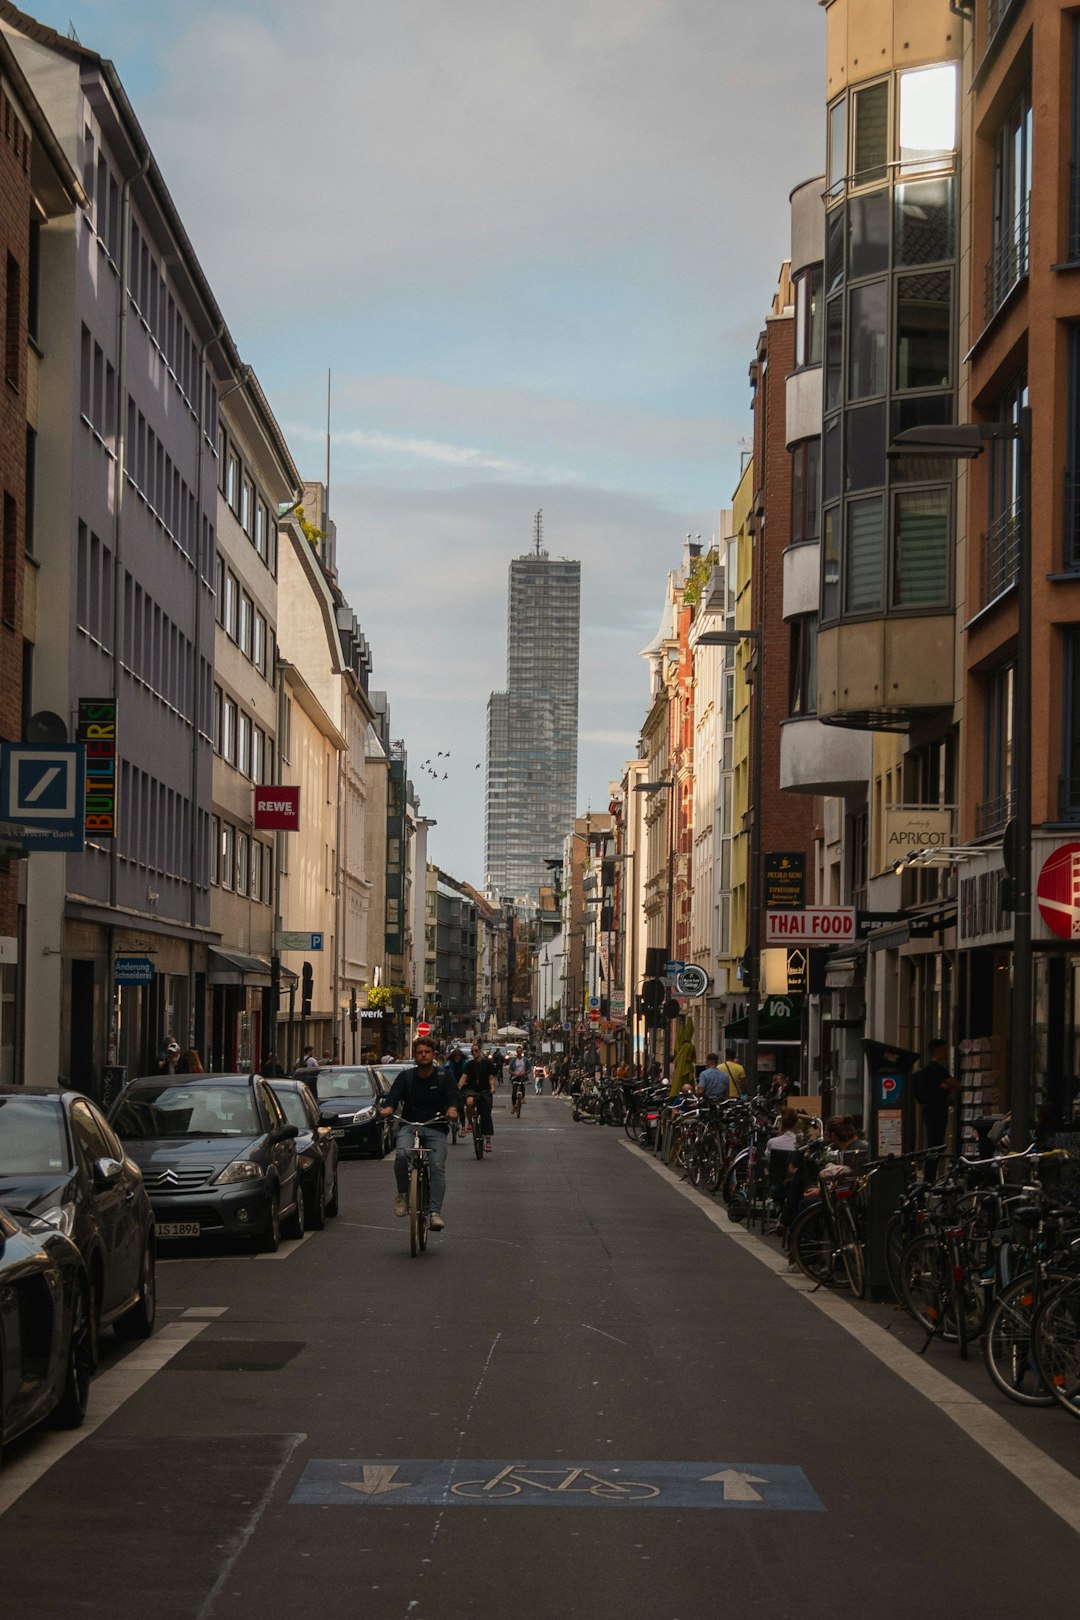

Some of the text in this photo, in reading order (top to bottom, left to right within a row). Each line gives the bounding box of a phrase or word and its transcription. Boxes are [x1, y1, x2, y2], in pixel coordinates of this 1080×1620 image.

[85, 705, 115, 830] BUTLERS
[257, 801, 293, 812] REWE
[53, 830, 75, 838] Bank
[889, 832, 947, 845] APRICOT
[769, 914, 853, 934] THAI FOOD
[313, 935, 321, 948] P
[115, 961, 150, 973] Änderung
[114, 971, 152, 979] Schneiderei
[158, 1225, 199, 1235] IS 1896
